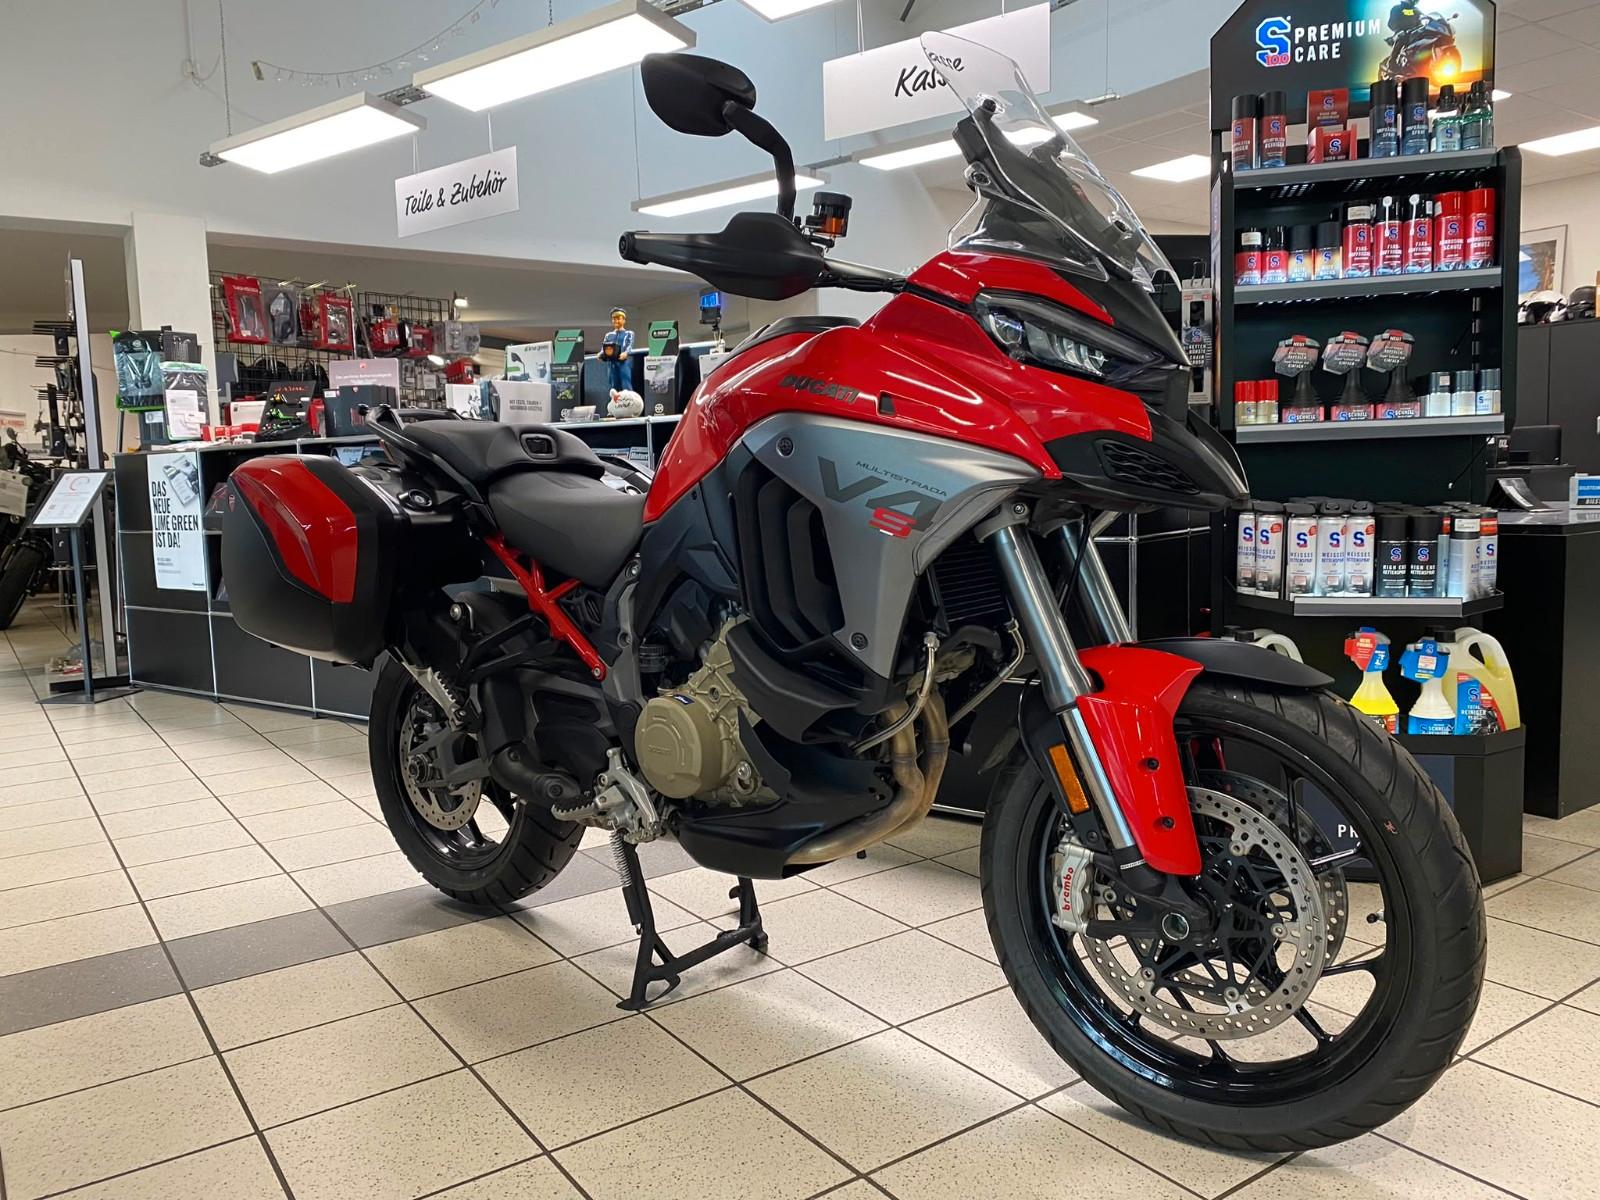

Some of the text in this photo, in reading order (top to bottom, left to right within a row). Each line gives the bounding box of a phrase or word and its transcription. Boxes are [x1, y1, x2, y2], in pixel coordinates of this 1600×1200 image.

[1294, 19, 1381, 44] PREMIUM
[1295, 42, 1341, 63] CARE
[405, 169, 507, 216] Teile & Zubehör
[779, 374, 859, 405] DUCATI
[152, 481, 166, 497] DAS
[855, 460, 948, 497] MULTISTRADA
[153, 498, 171, 513] NEUE
[154, 515, 199, 531] LIME GREEN
[869, 507, 917, 539] S
[155, 532, 181, 548] IST DA!
[1062, 866, 1074, 912] brembo
